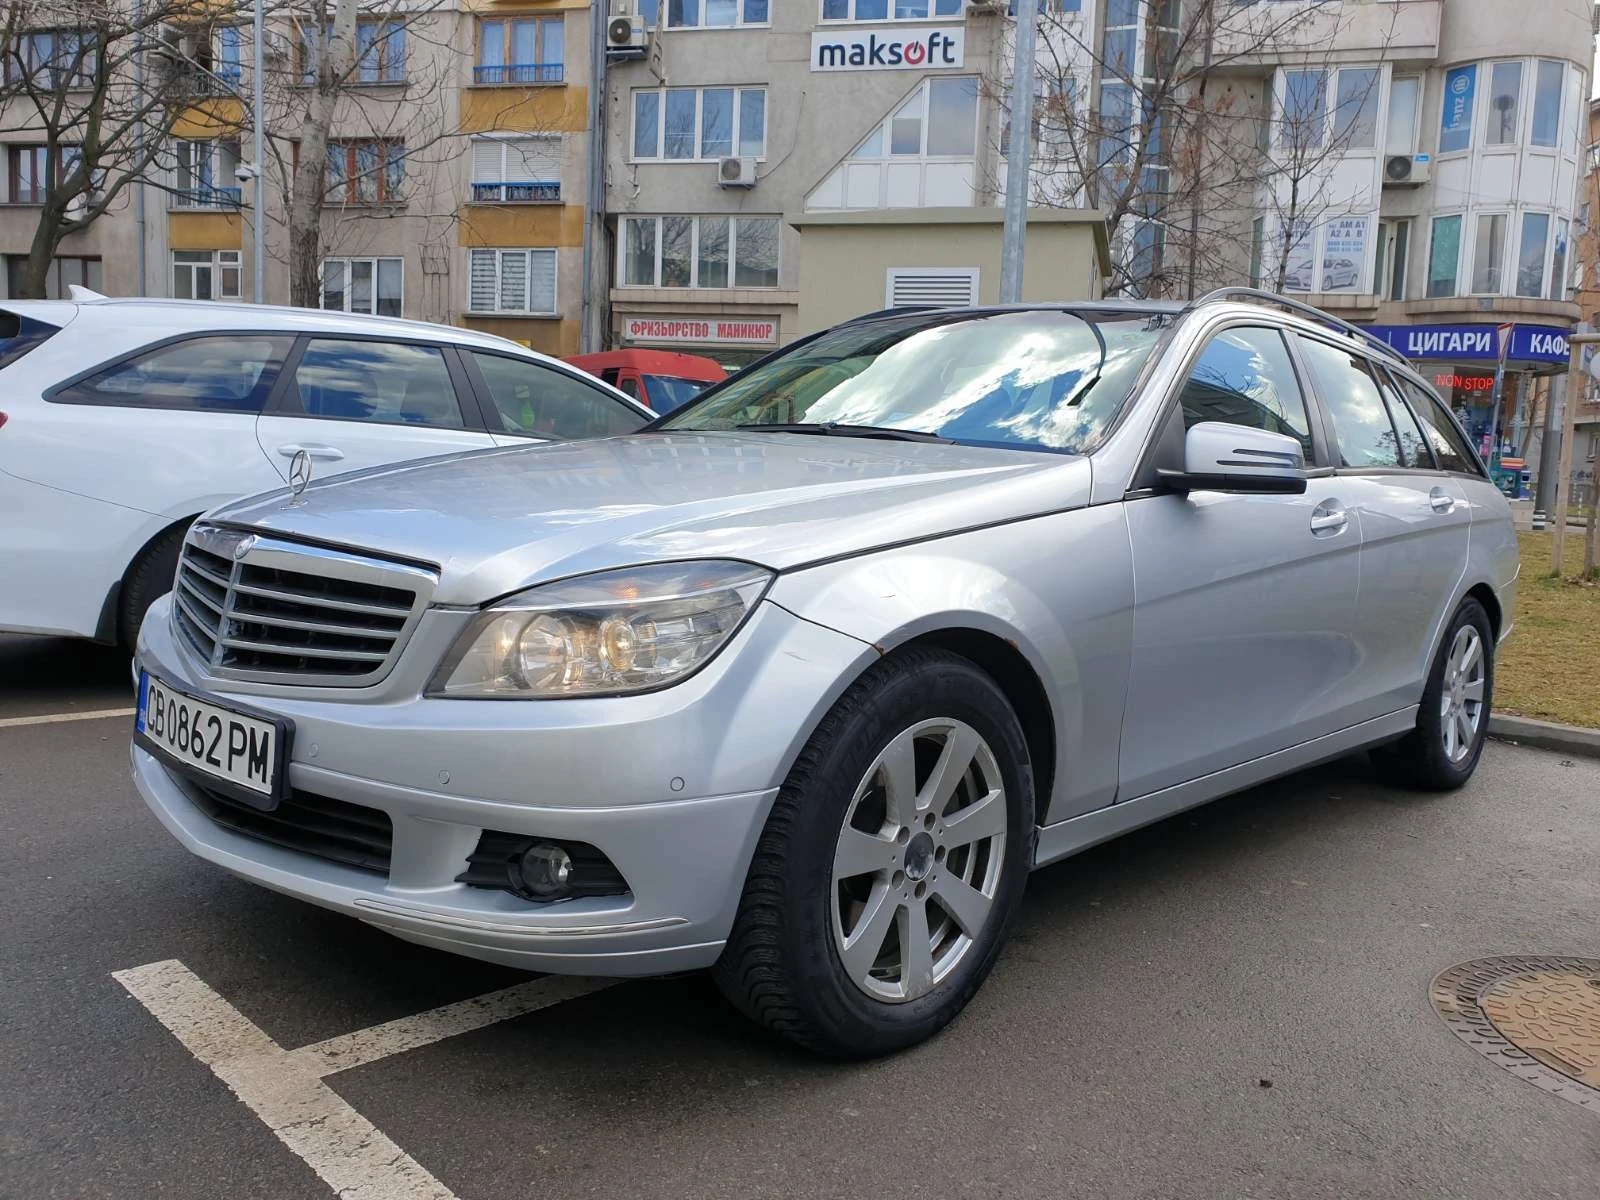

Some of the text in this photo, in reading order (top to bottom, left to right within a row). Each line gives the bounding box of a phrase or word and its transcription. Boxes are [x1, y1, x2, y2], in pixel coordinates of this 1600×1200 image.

[819, 32, 955, 67] maksoft
[630, 321, 772, 339] ФРИЗЬОРСТВО МАНИКЮР
[1408, 332, 1491, 355] ЦИГАРИ
[1436, 373, 1494, 391] NON STOP
